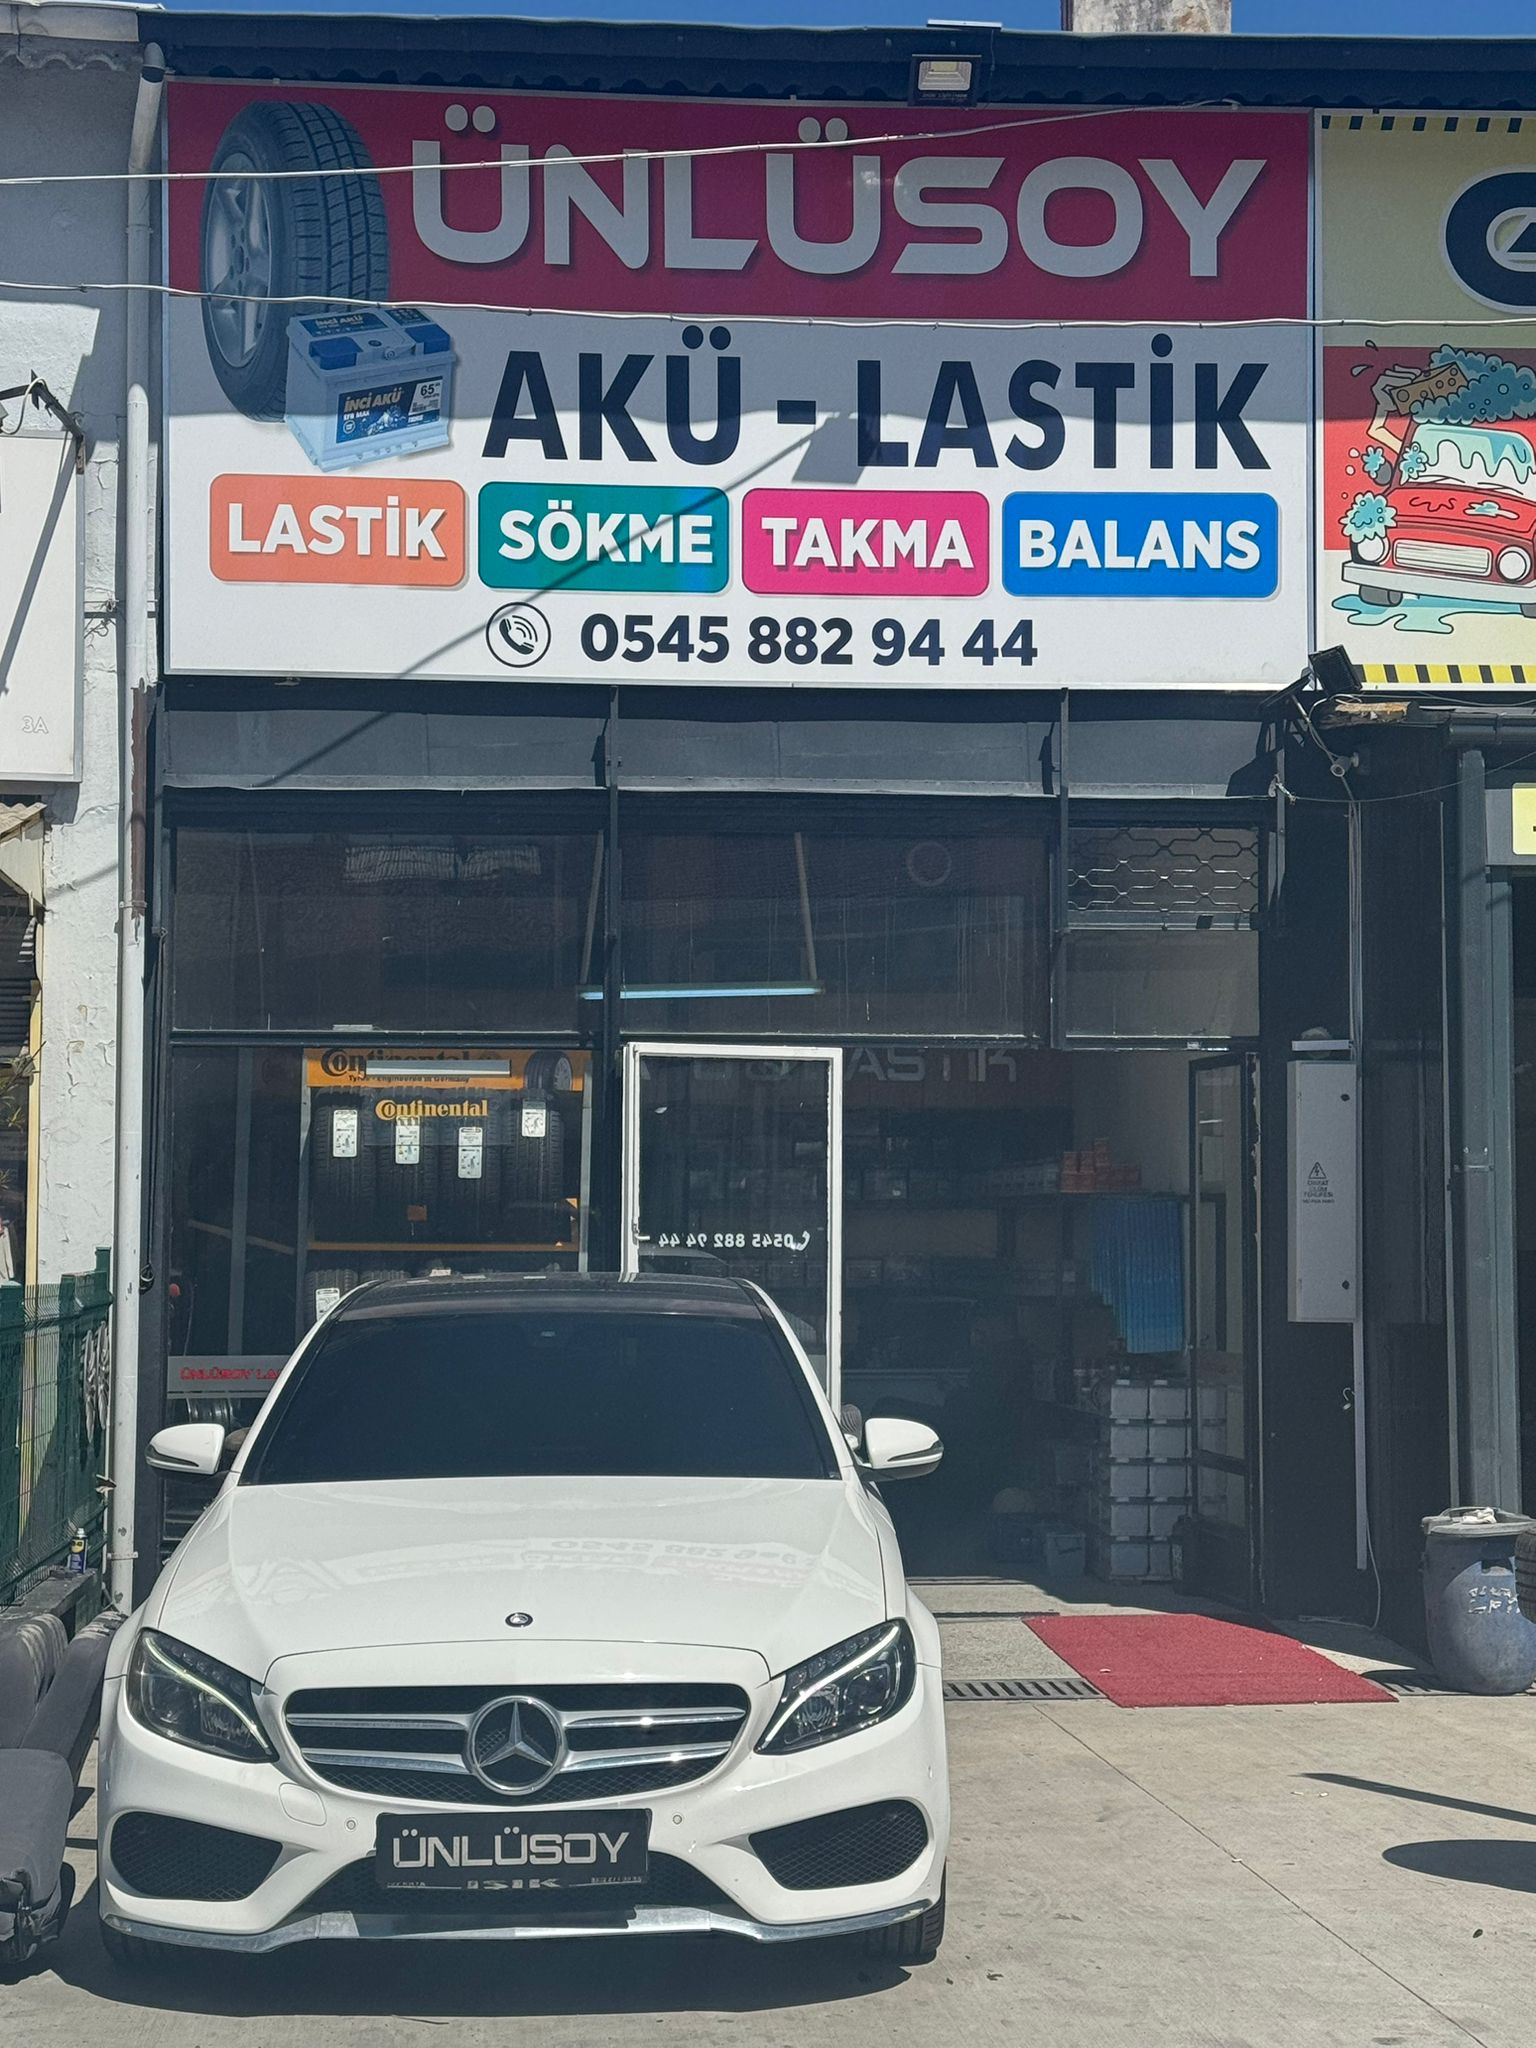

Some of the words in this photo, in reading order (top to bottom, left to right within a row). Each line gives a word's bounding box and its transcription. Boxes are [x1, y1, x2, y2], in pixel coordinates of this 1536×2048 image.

[411, 103, 1266, 279] ÜNLÜSOY
[372, 387, 402, 408] AKÜ
[420, 384, 435, 396] 65
[482, 325, 742, 466] AKÜ
[857, 333, 1271, 470] LASTİK
[226, 495, 447, 560] LASTİK
[498, 499, 713, 564] SÖKME
[761, 516, 975, 570] TAKMA
[1018, 520, 1262, 571] BALANS
[581, 614, 729, 663] 0545
[747, 616, 853, 664] 882
[871, 618, 945, 666] 94
[962, 620, 1038, 667] 44
[22, 716, 48, 734] 3A
[375, 1099, 489, 1121] Continental
[392, 1826, 630, 1868] ÜNLÜSOY
